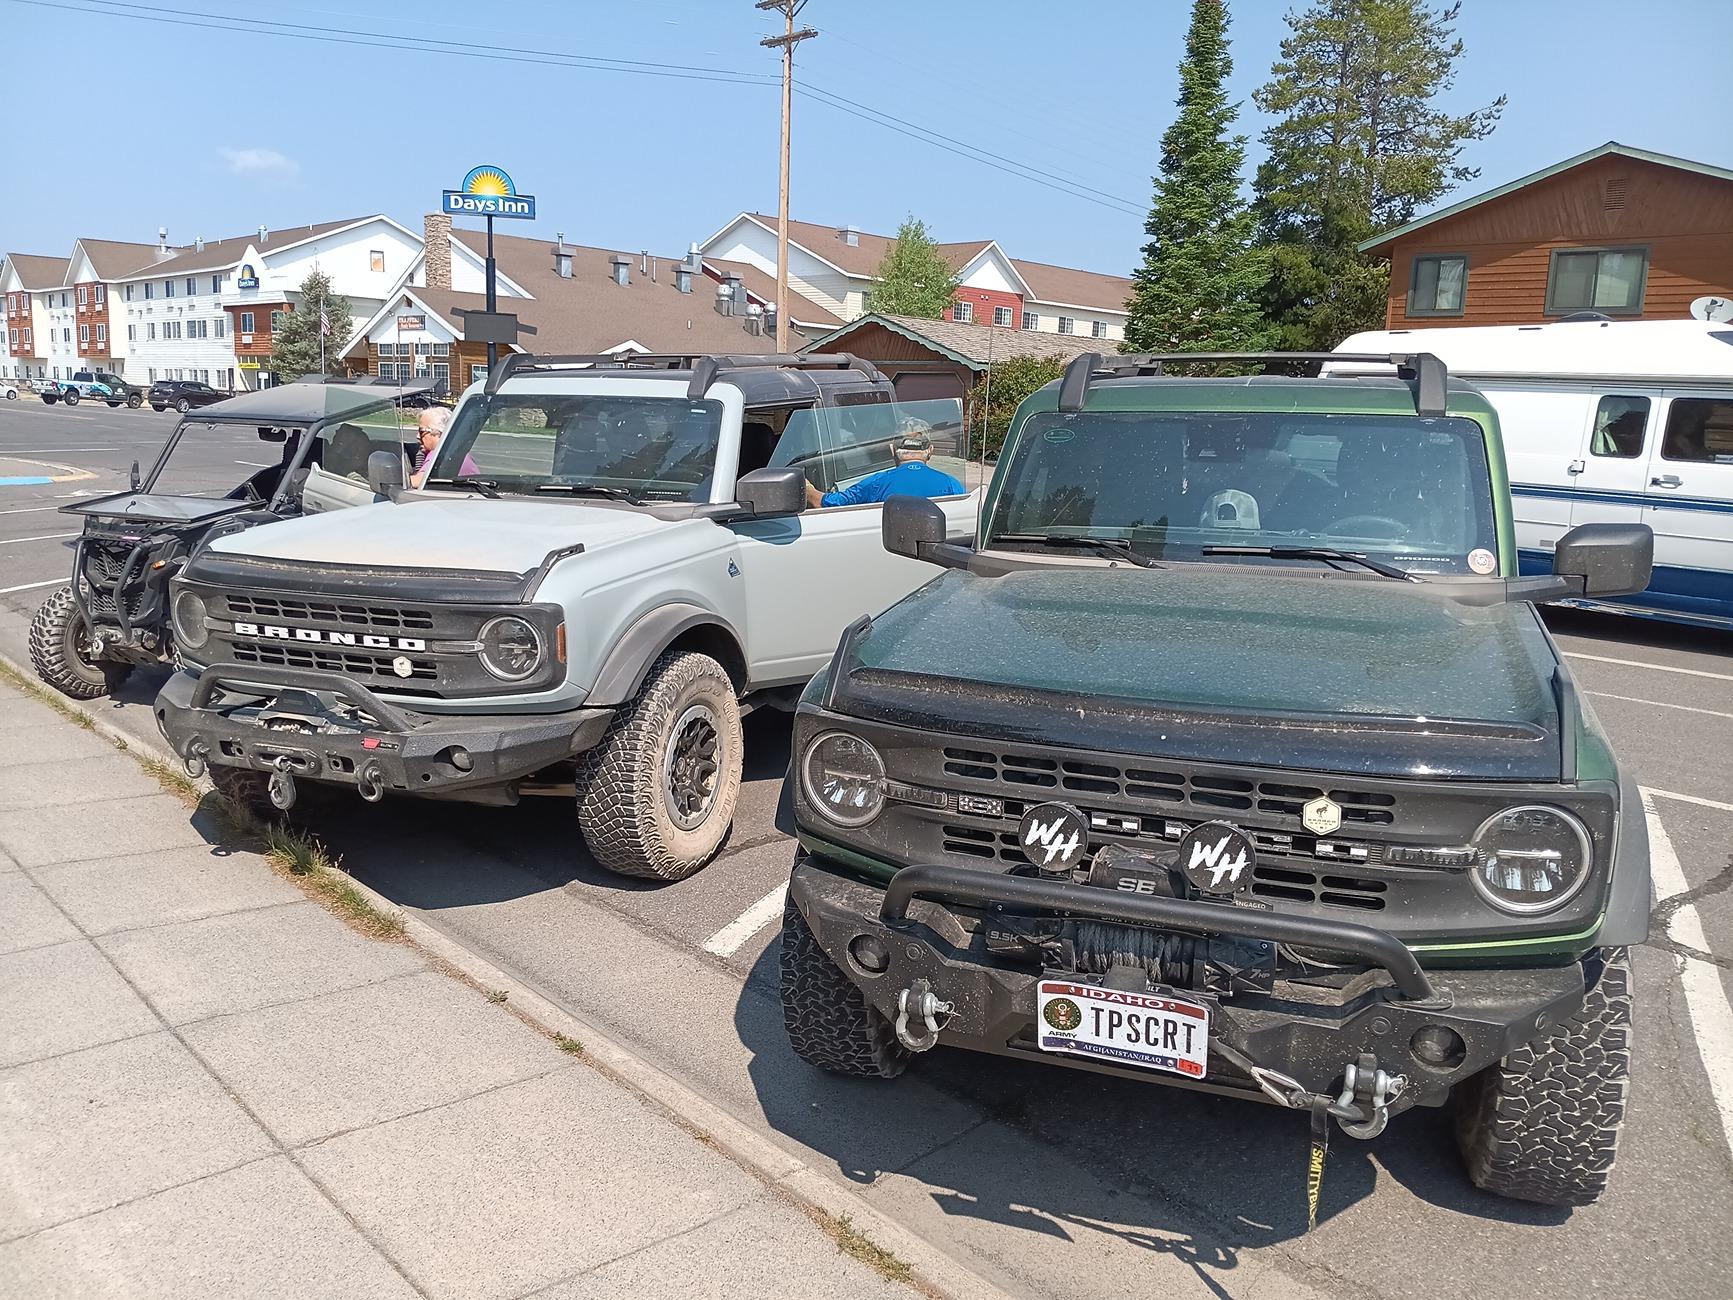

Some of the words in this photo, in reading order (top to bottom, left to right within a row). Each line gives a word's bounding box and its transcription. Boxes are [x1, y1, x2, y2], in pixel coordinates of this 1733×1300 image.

[449, 195, 496, 212] Days
[498, 198, 529, 213] Inn
[234, 622, 426, 651] BRONCO
[1081, 988, 1165, 1009] IDAHO
[1048, 1031, 1078, 1039] ARMY
[1090, 1006, 1197, 1054] TPSCRT
